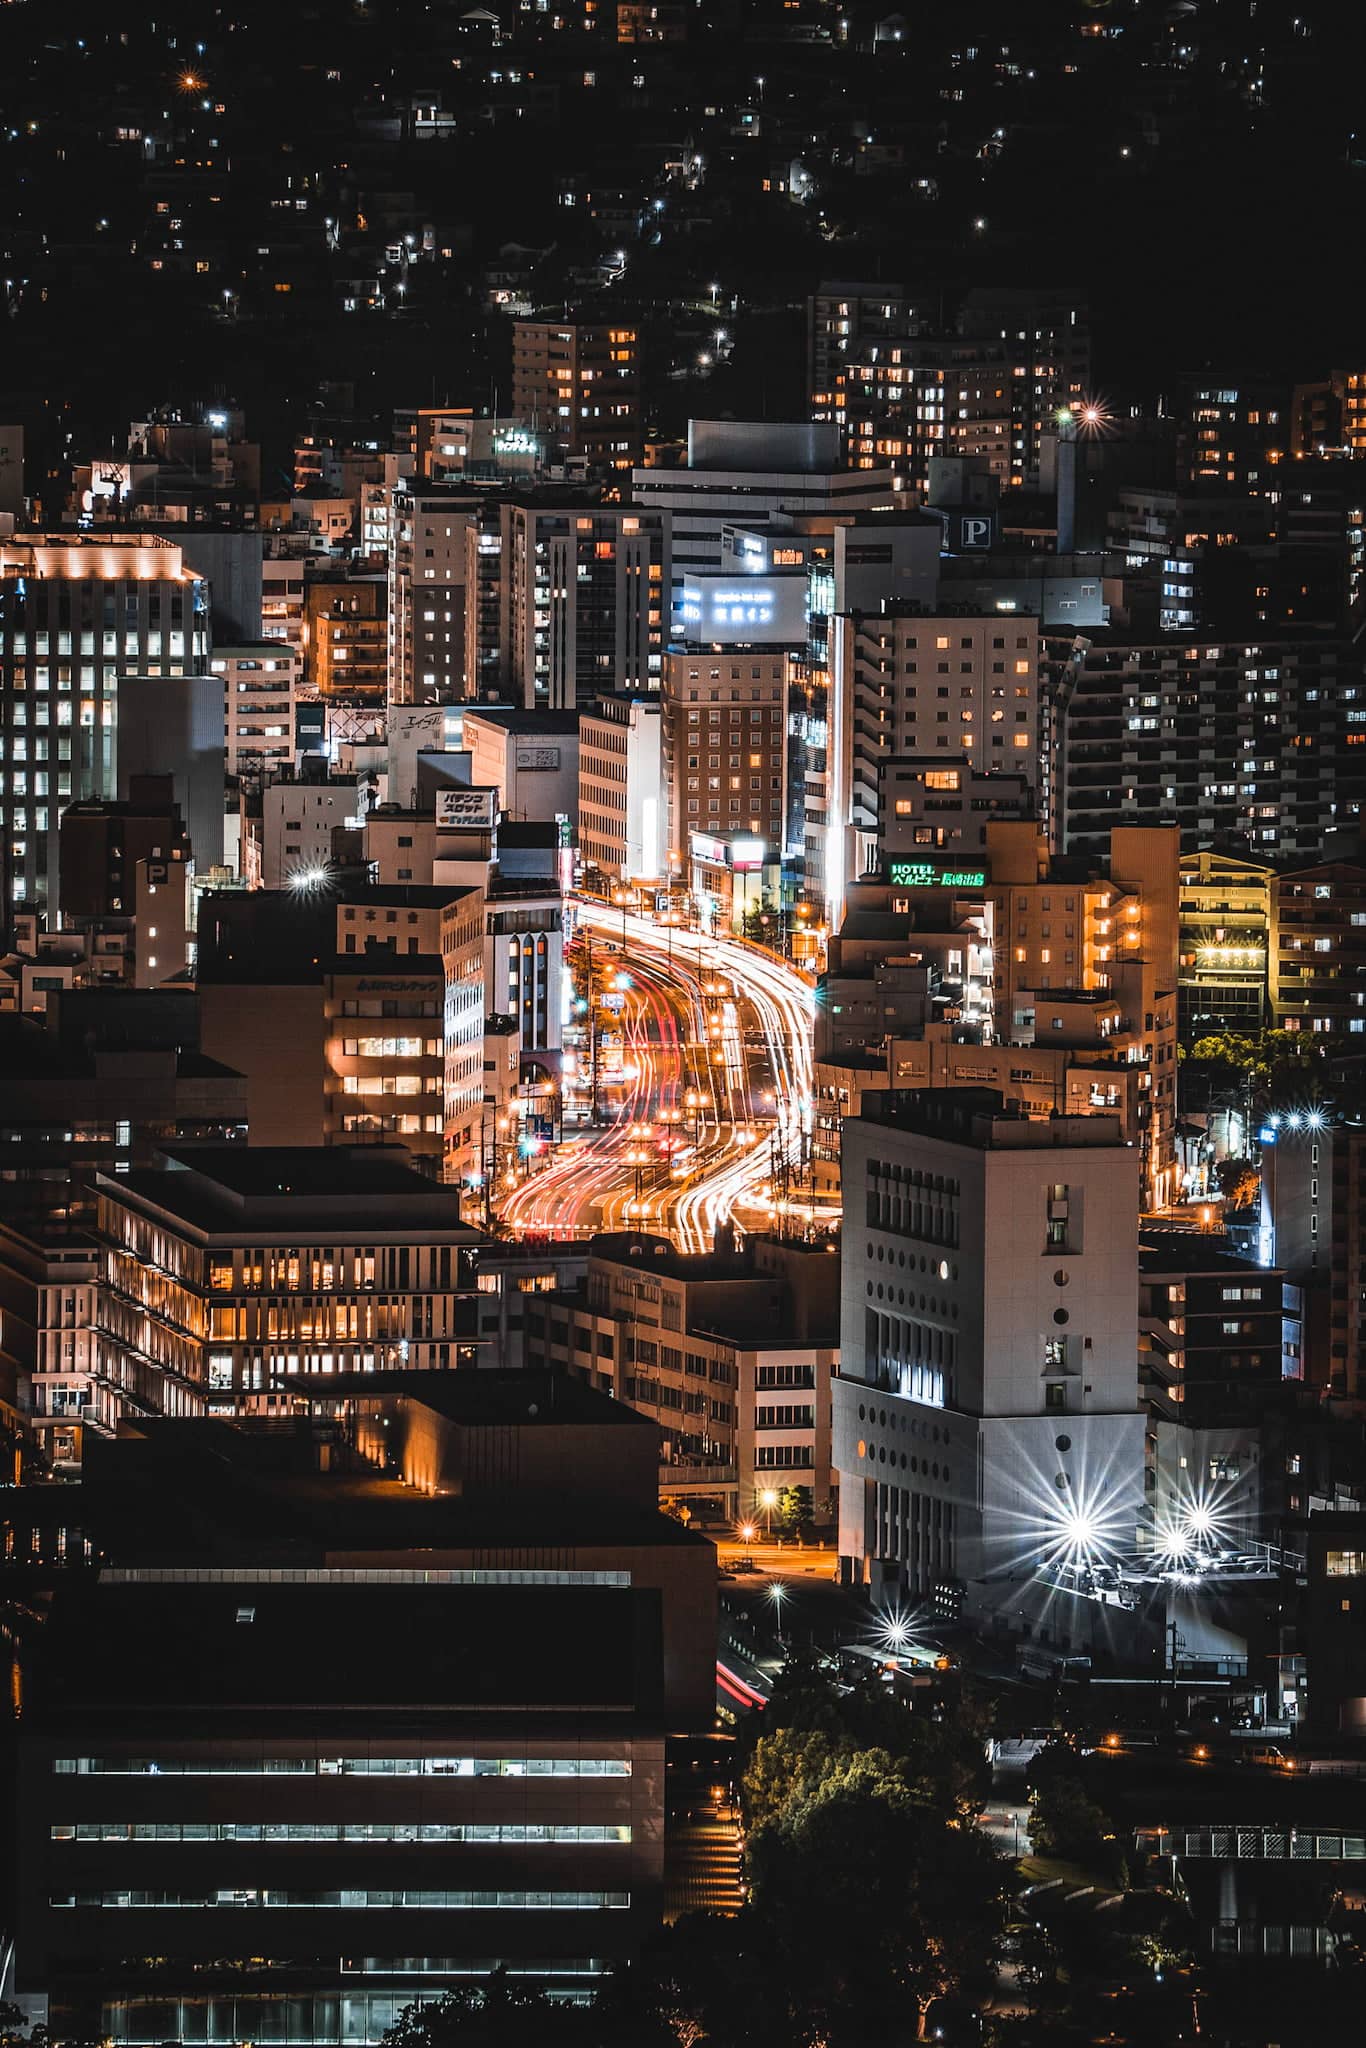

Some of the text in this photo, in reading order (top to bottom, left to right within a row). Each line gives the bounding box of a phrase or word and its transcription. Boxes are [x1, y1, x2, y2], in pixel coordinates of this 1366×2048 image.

[965, 520, 986, 545] P
[444, 793, 484, 803] パチンコ
[444, 804, 483, 813] スロット
[149, 865, 166, 883] P
[892, 865, 935, 875] HOTEL
